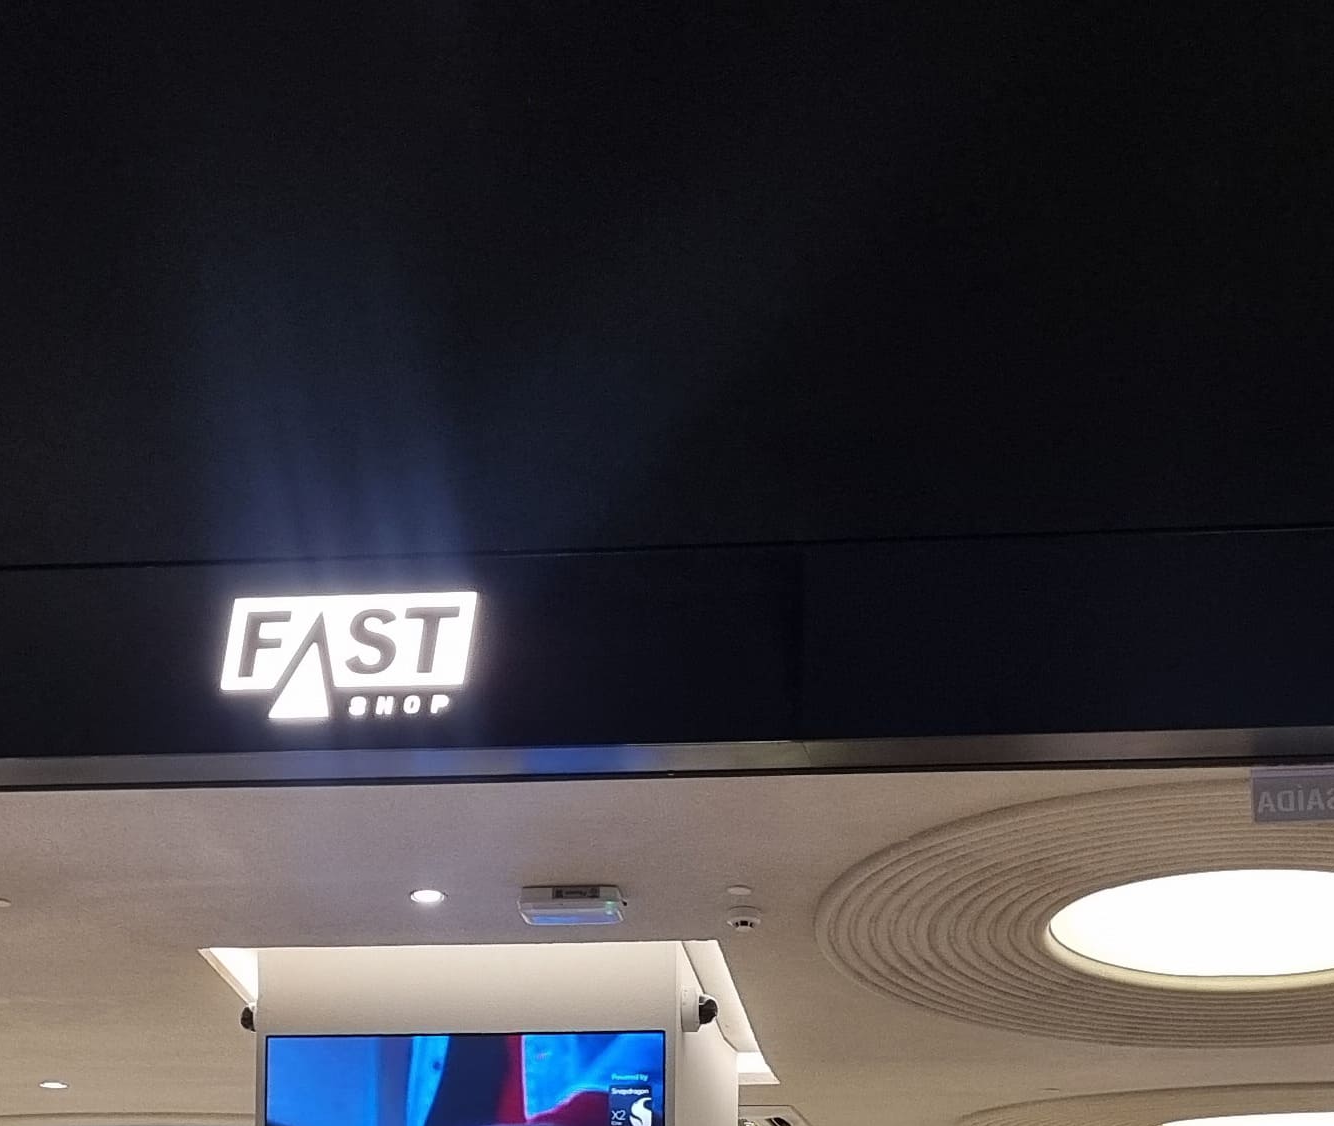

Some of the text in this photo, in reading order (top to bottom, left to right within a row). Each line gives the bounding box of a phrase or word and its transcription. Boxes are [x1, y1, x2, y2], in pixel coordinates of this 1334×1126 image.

[235, 604, 463, 718] FAST
[348, 694, 451, 717] SHOP
[611, 1087, 649, 1095] Snapdragon
[611, 1110, 626, 1120] X2
